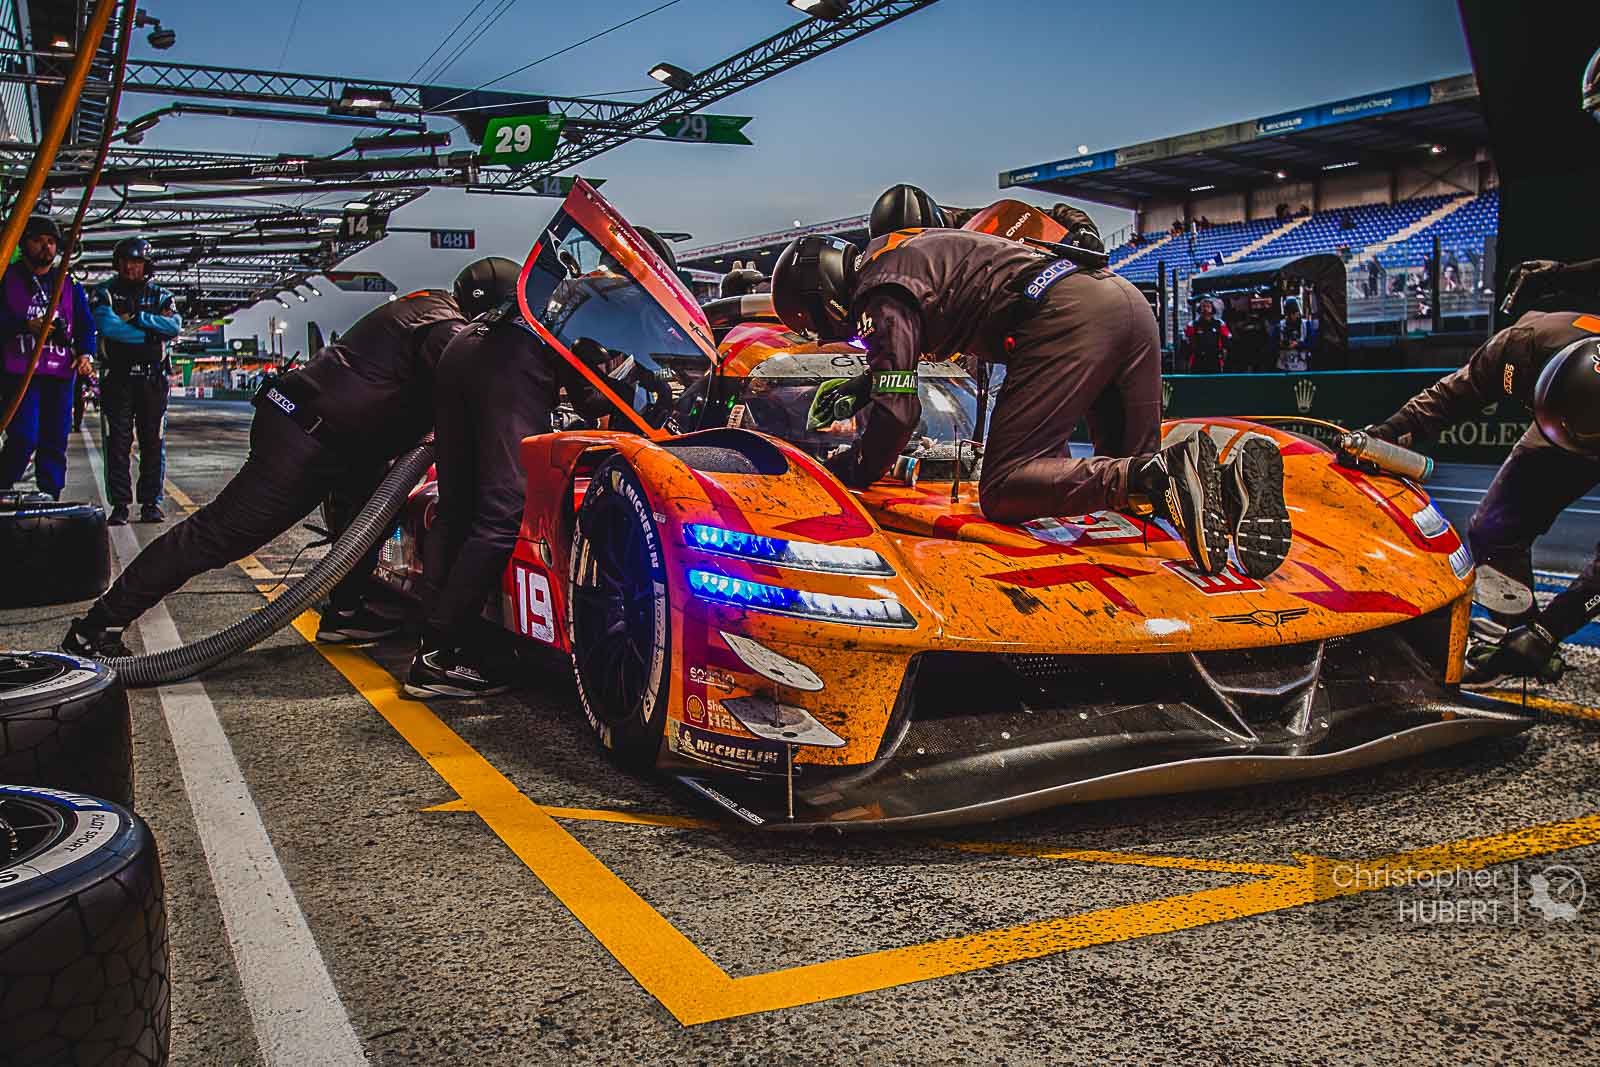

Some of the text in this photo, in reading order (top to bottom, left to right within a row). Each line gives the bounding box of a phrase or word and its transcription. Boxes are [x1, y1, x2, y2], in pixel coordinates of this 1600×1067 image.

[496, 124, 532, 152] 29
[676, 115, 708, 141] 29
[543, 176, 561, 194] 14
[348, 215, 369, 235] 14
[1027, 259, 1074, 297] sparco
[266, 388, 296, 412] sparco
[625, 483, 660, 569] MICHELIN
[515, 566, 555, 643] 19
[696, 739, 779, 764] MICHELIN
[63, 813, 106, 853] PILOT SPORT
